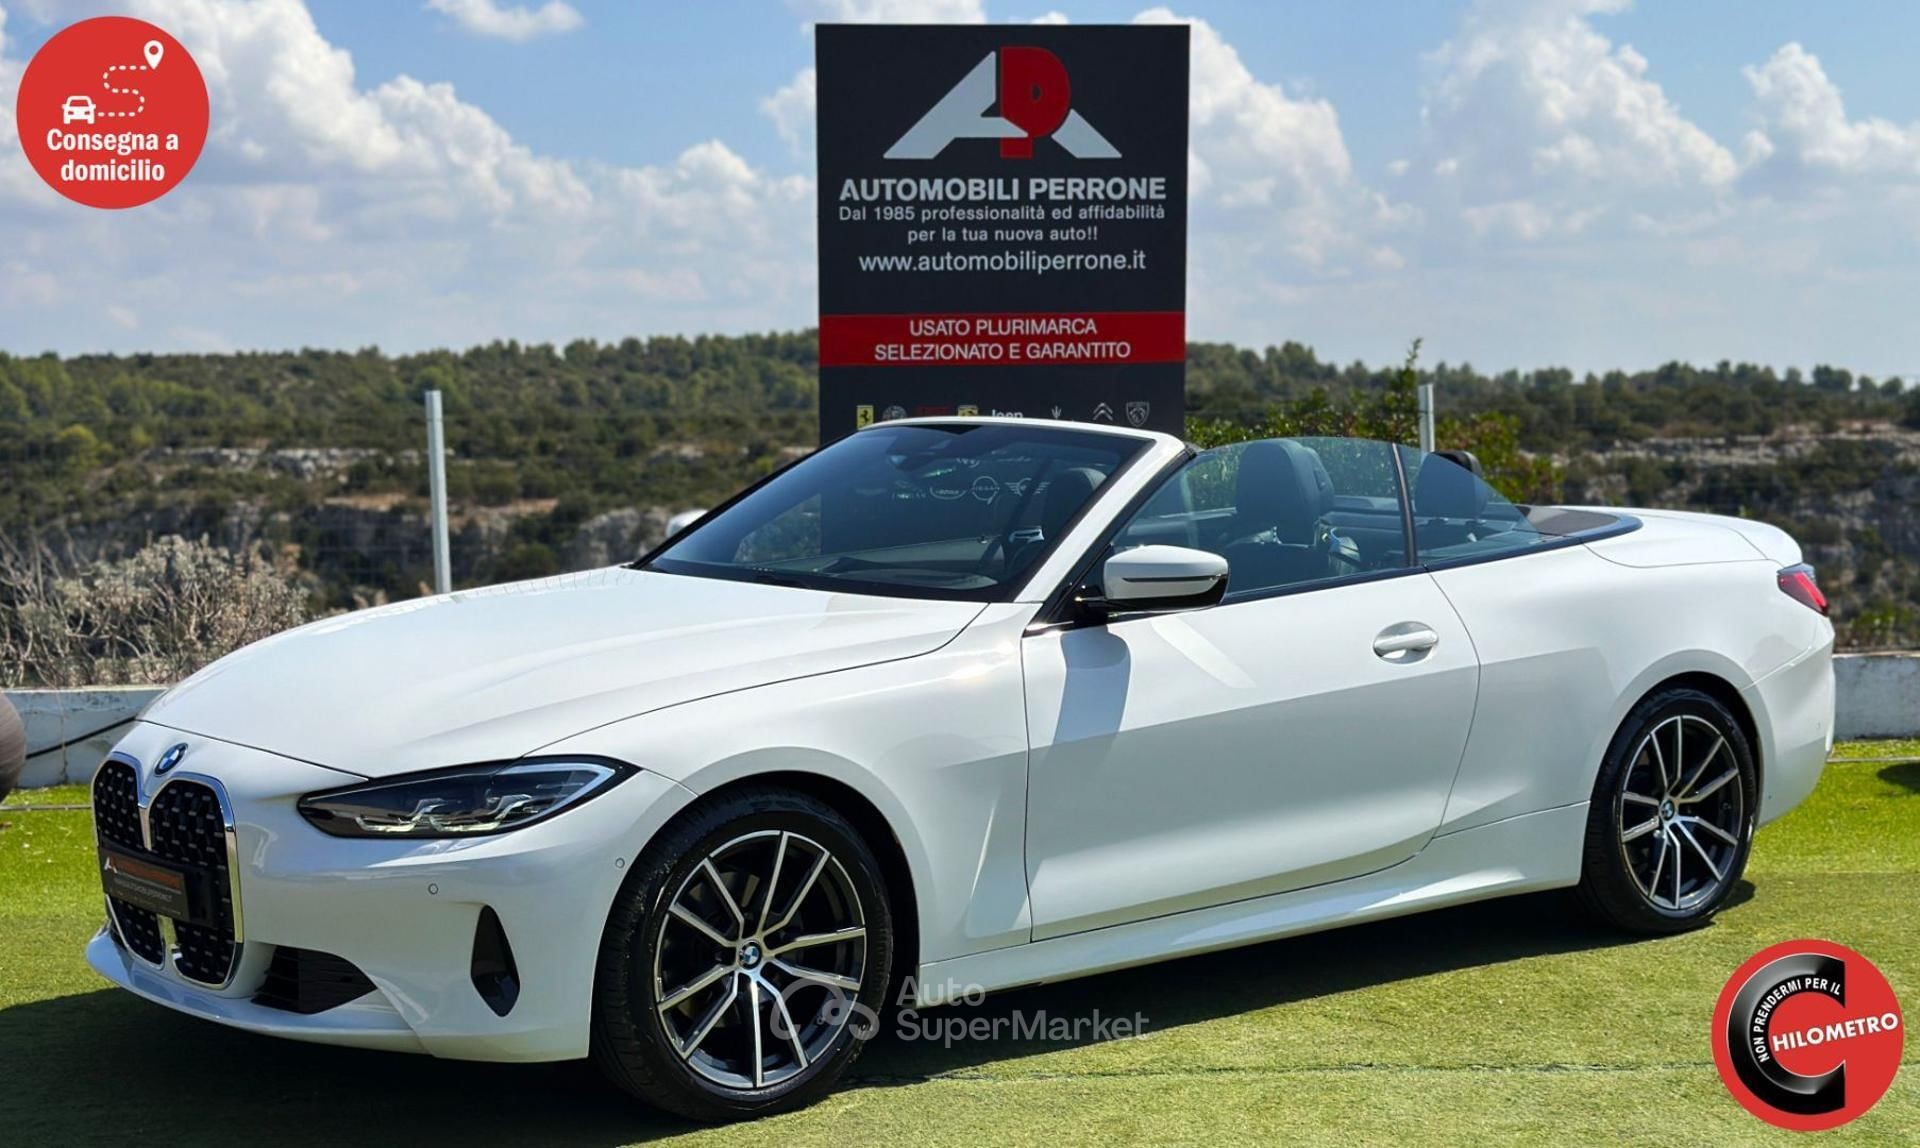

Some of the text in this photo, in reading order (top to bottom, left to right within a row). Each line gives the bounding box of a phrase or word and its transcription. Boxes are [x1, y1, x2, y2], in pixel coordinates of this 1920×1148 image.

[839, 177, 1167, 201] AUTOMOBILI PERRONE
[839, 204, 1166, 224] Dal 1985 professionalità ed affidabilità
[907, 227, 1099, 245] per la tua nuova auto!!
[859, 250, 1147, 274] www.automobiliperrone.it
[909, 318, 1097, 337] USATO PLURIMARCA
[874, 342, 1131, 361] SELEZIONATO E GARANTITO
